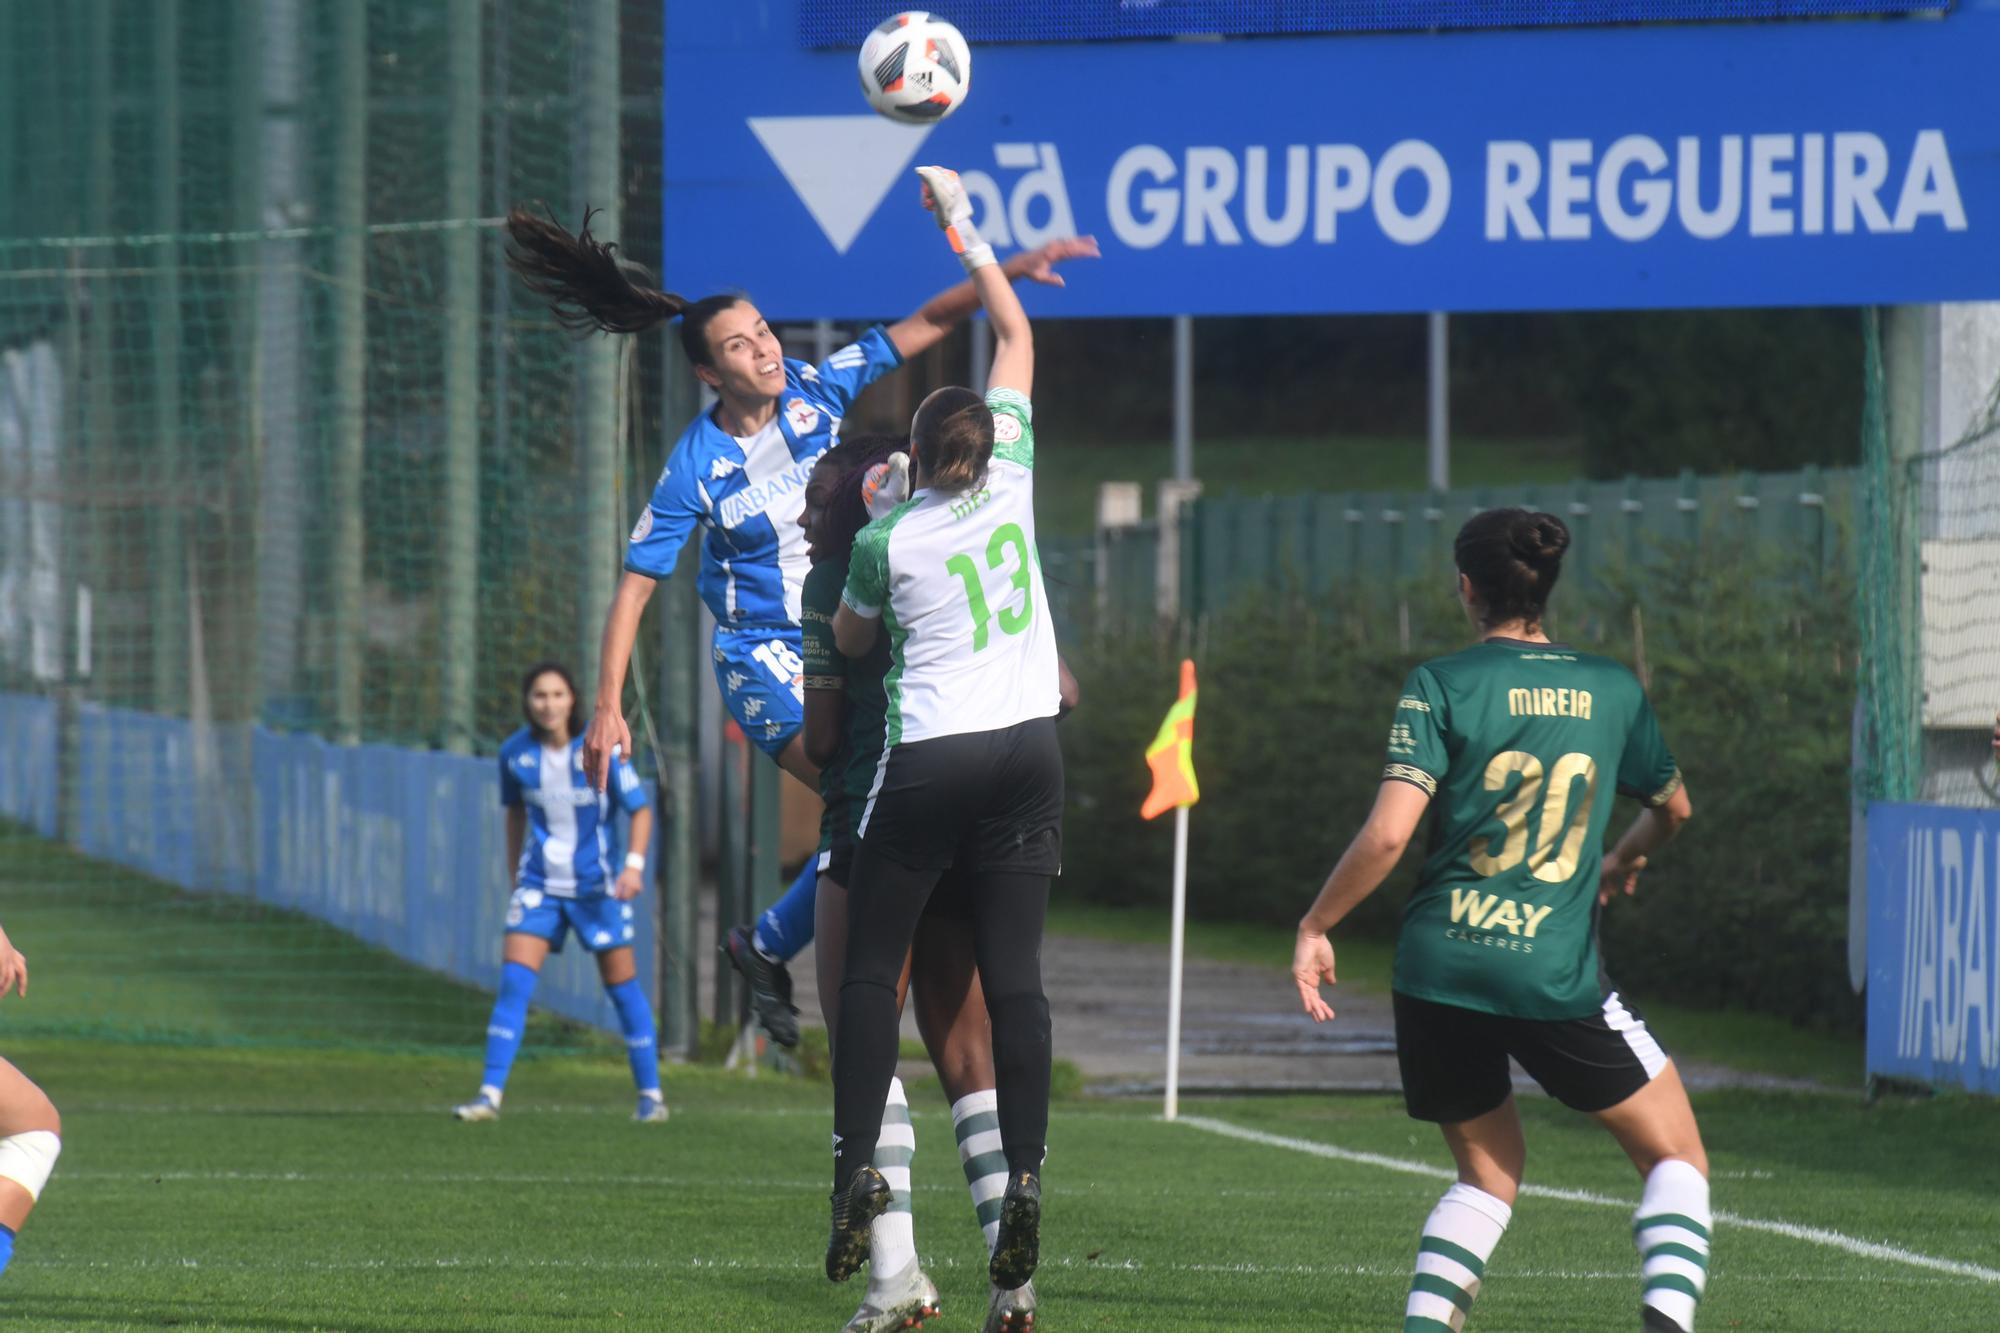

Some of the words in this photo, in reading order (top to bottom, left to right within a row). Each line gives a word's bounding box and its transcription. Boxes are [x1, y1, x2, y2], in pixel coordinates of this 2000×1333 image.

[1106, 139, 1452, 249] GRUPO
[1485, 129, 1969, 242] REGUEIRA
[720, 449, 823, 529] ABANC
[945, 523, 1033, 653] 13
[751, 639, 803, 684] 18
[1508, 687, 1592, 720] MIREIA
[1469, 751, 1596, 883] 30
[1451, 888, 1553, 938] WAY
[1900, 828, 2000, 1070] ABA
